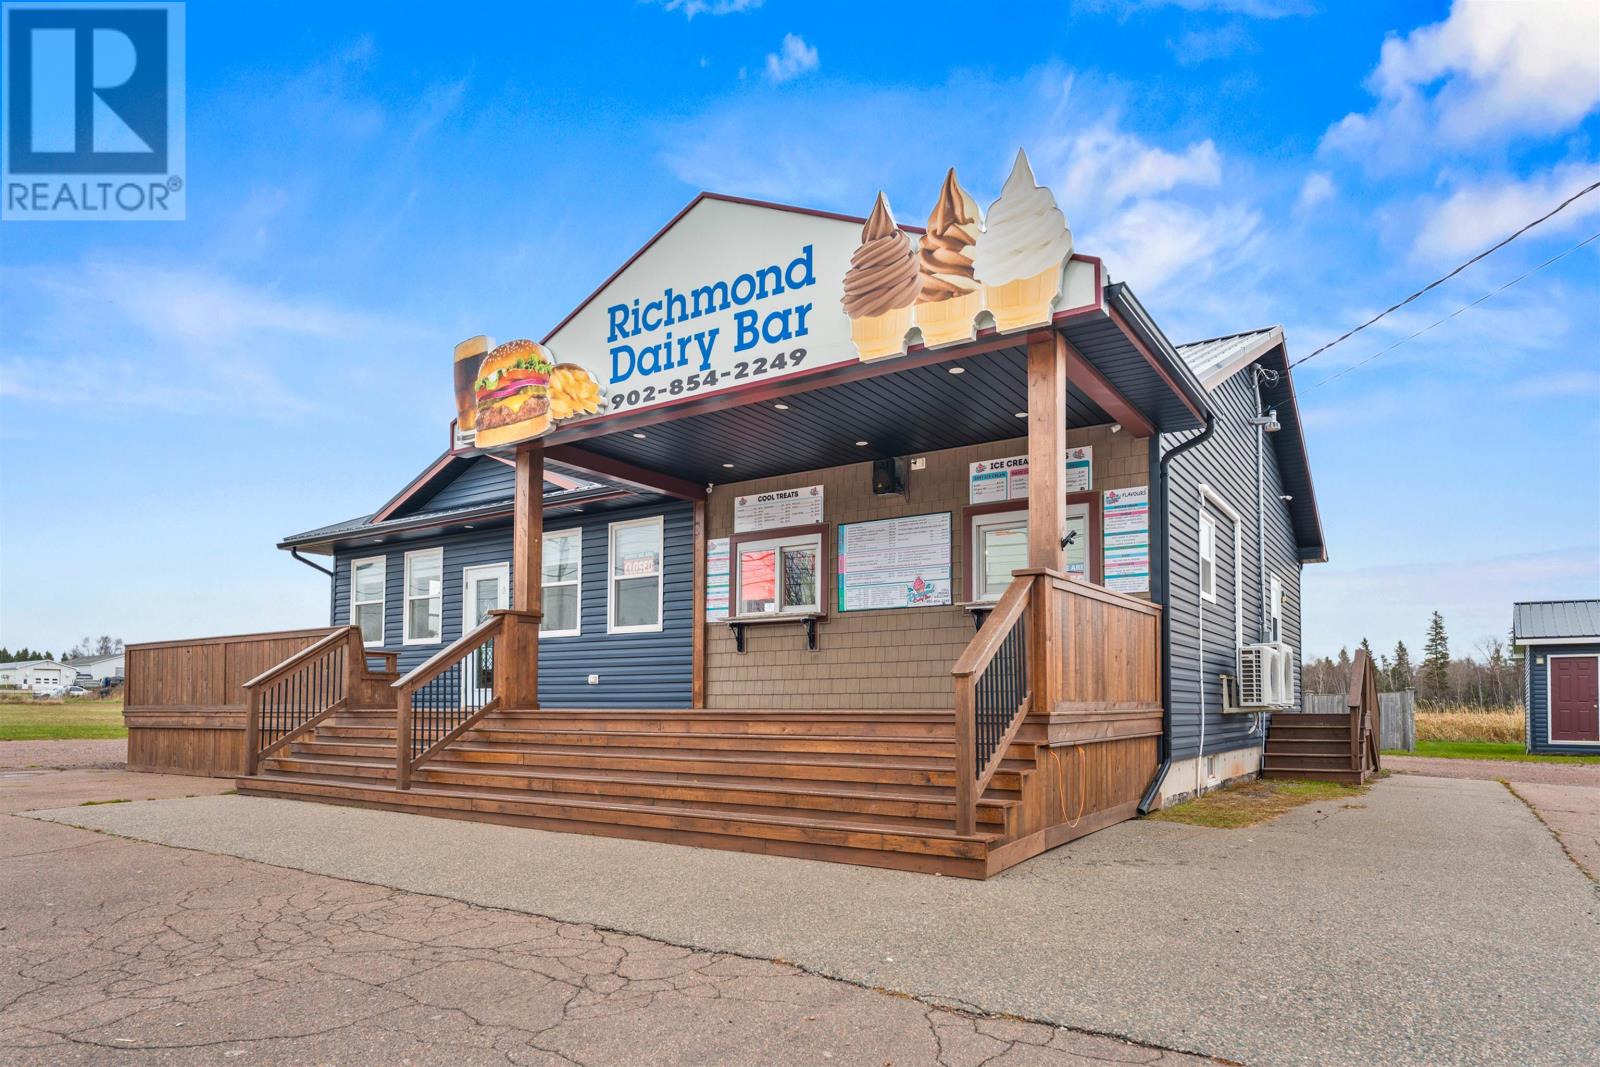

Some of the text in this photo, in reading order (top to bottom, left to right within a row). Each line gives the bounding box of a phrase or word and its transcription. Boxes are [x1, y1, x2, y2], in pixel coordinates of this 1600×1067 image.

[607, 244, 816, 343] Richmond
[609, 302, 813, 384] Dairy Bar
[611, 348, 808, 410] 902-854-2249
[990, 459, 1029, 470] ICE CREA
[757, 490, 799, 502] COOL TREATS
